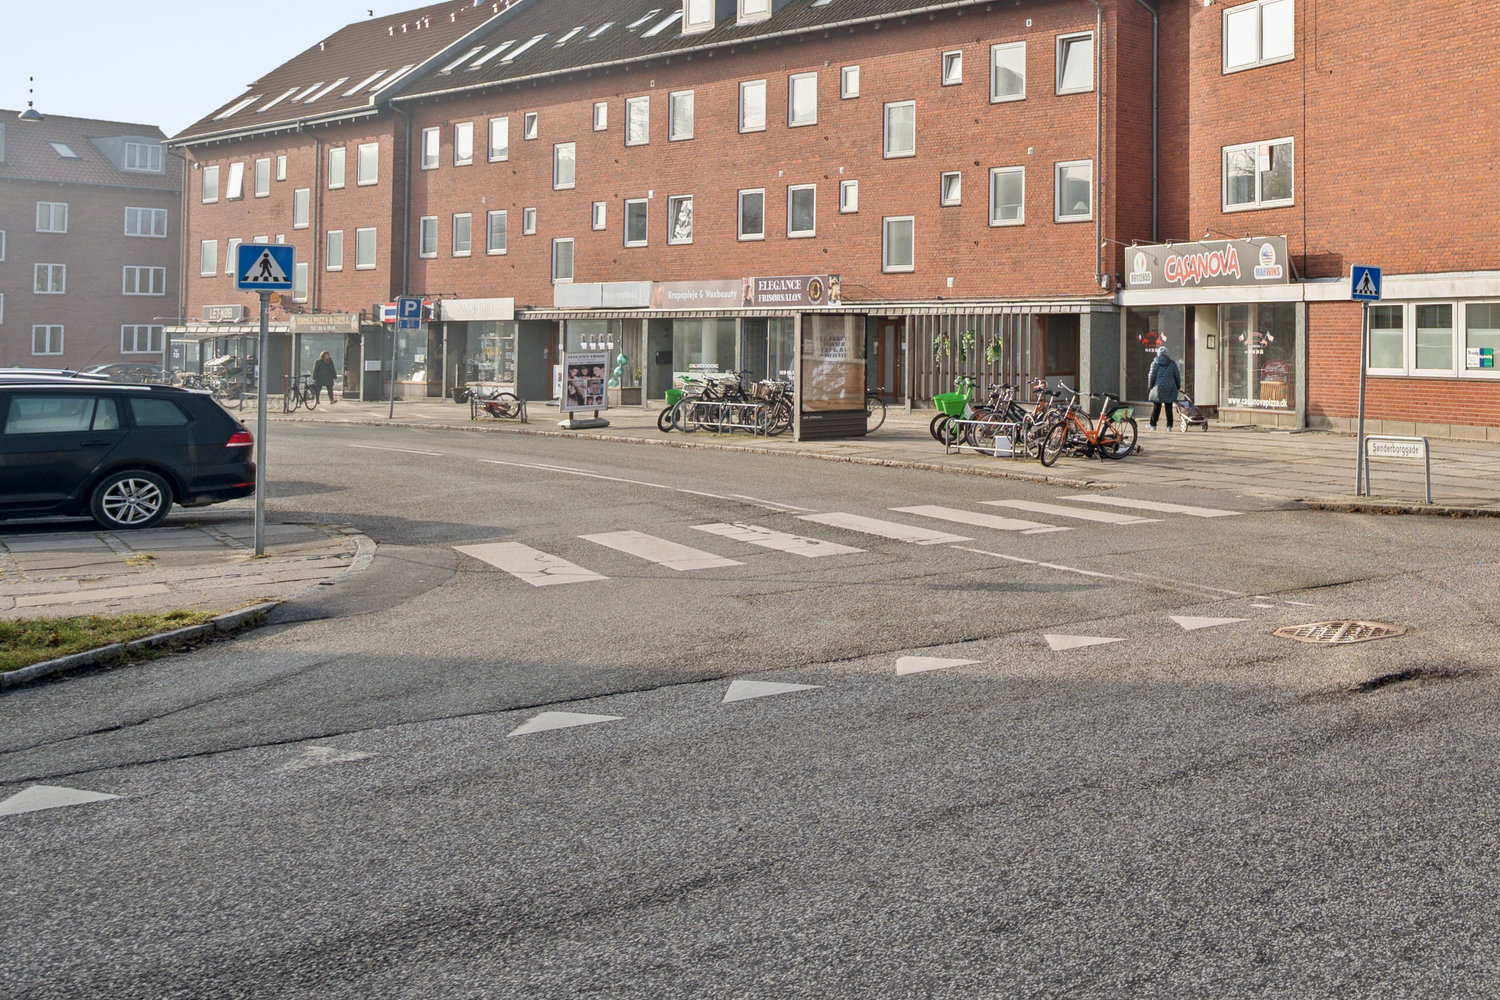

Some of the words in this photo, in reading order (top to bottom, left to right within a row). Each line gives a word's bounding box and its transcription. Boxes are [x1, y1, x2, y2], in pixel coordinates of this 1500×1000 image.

[1165, 244, 1240, 285] CASANOVA
[1255, 266, 1281, 277] MARWINS
[758, 280, 802, 291] ELEGANCE
[758, 294, 802, 302] FRISØRSALON
[404, 300, 417, 316] P
[1372, 442, 1419, 456] Sønderborggade
